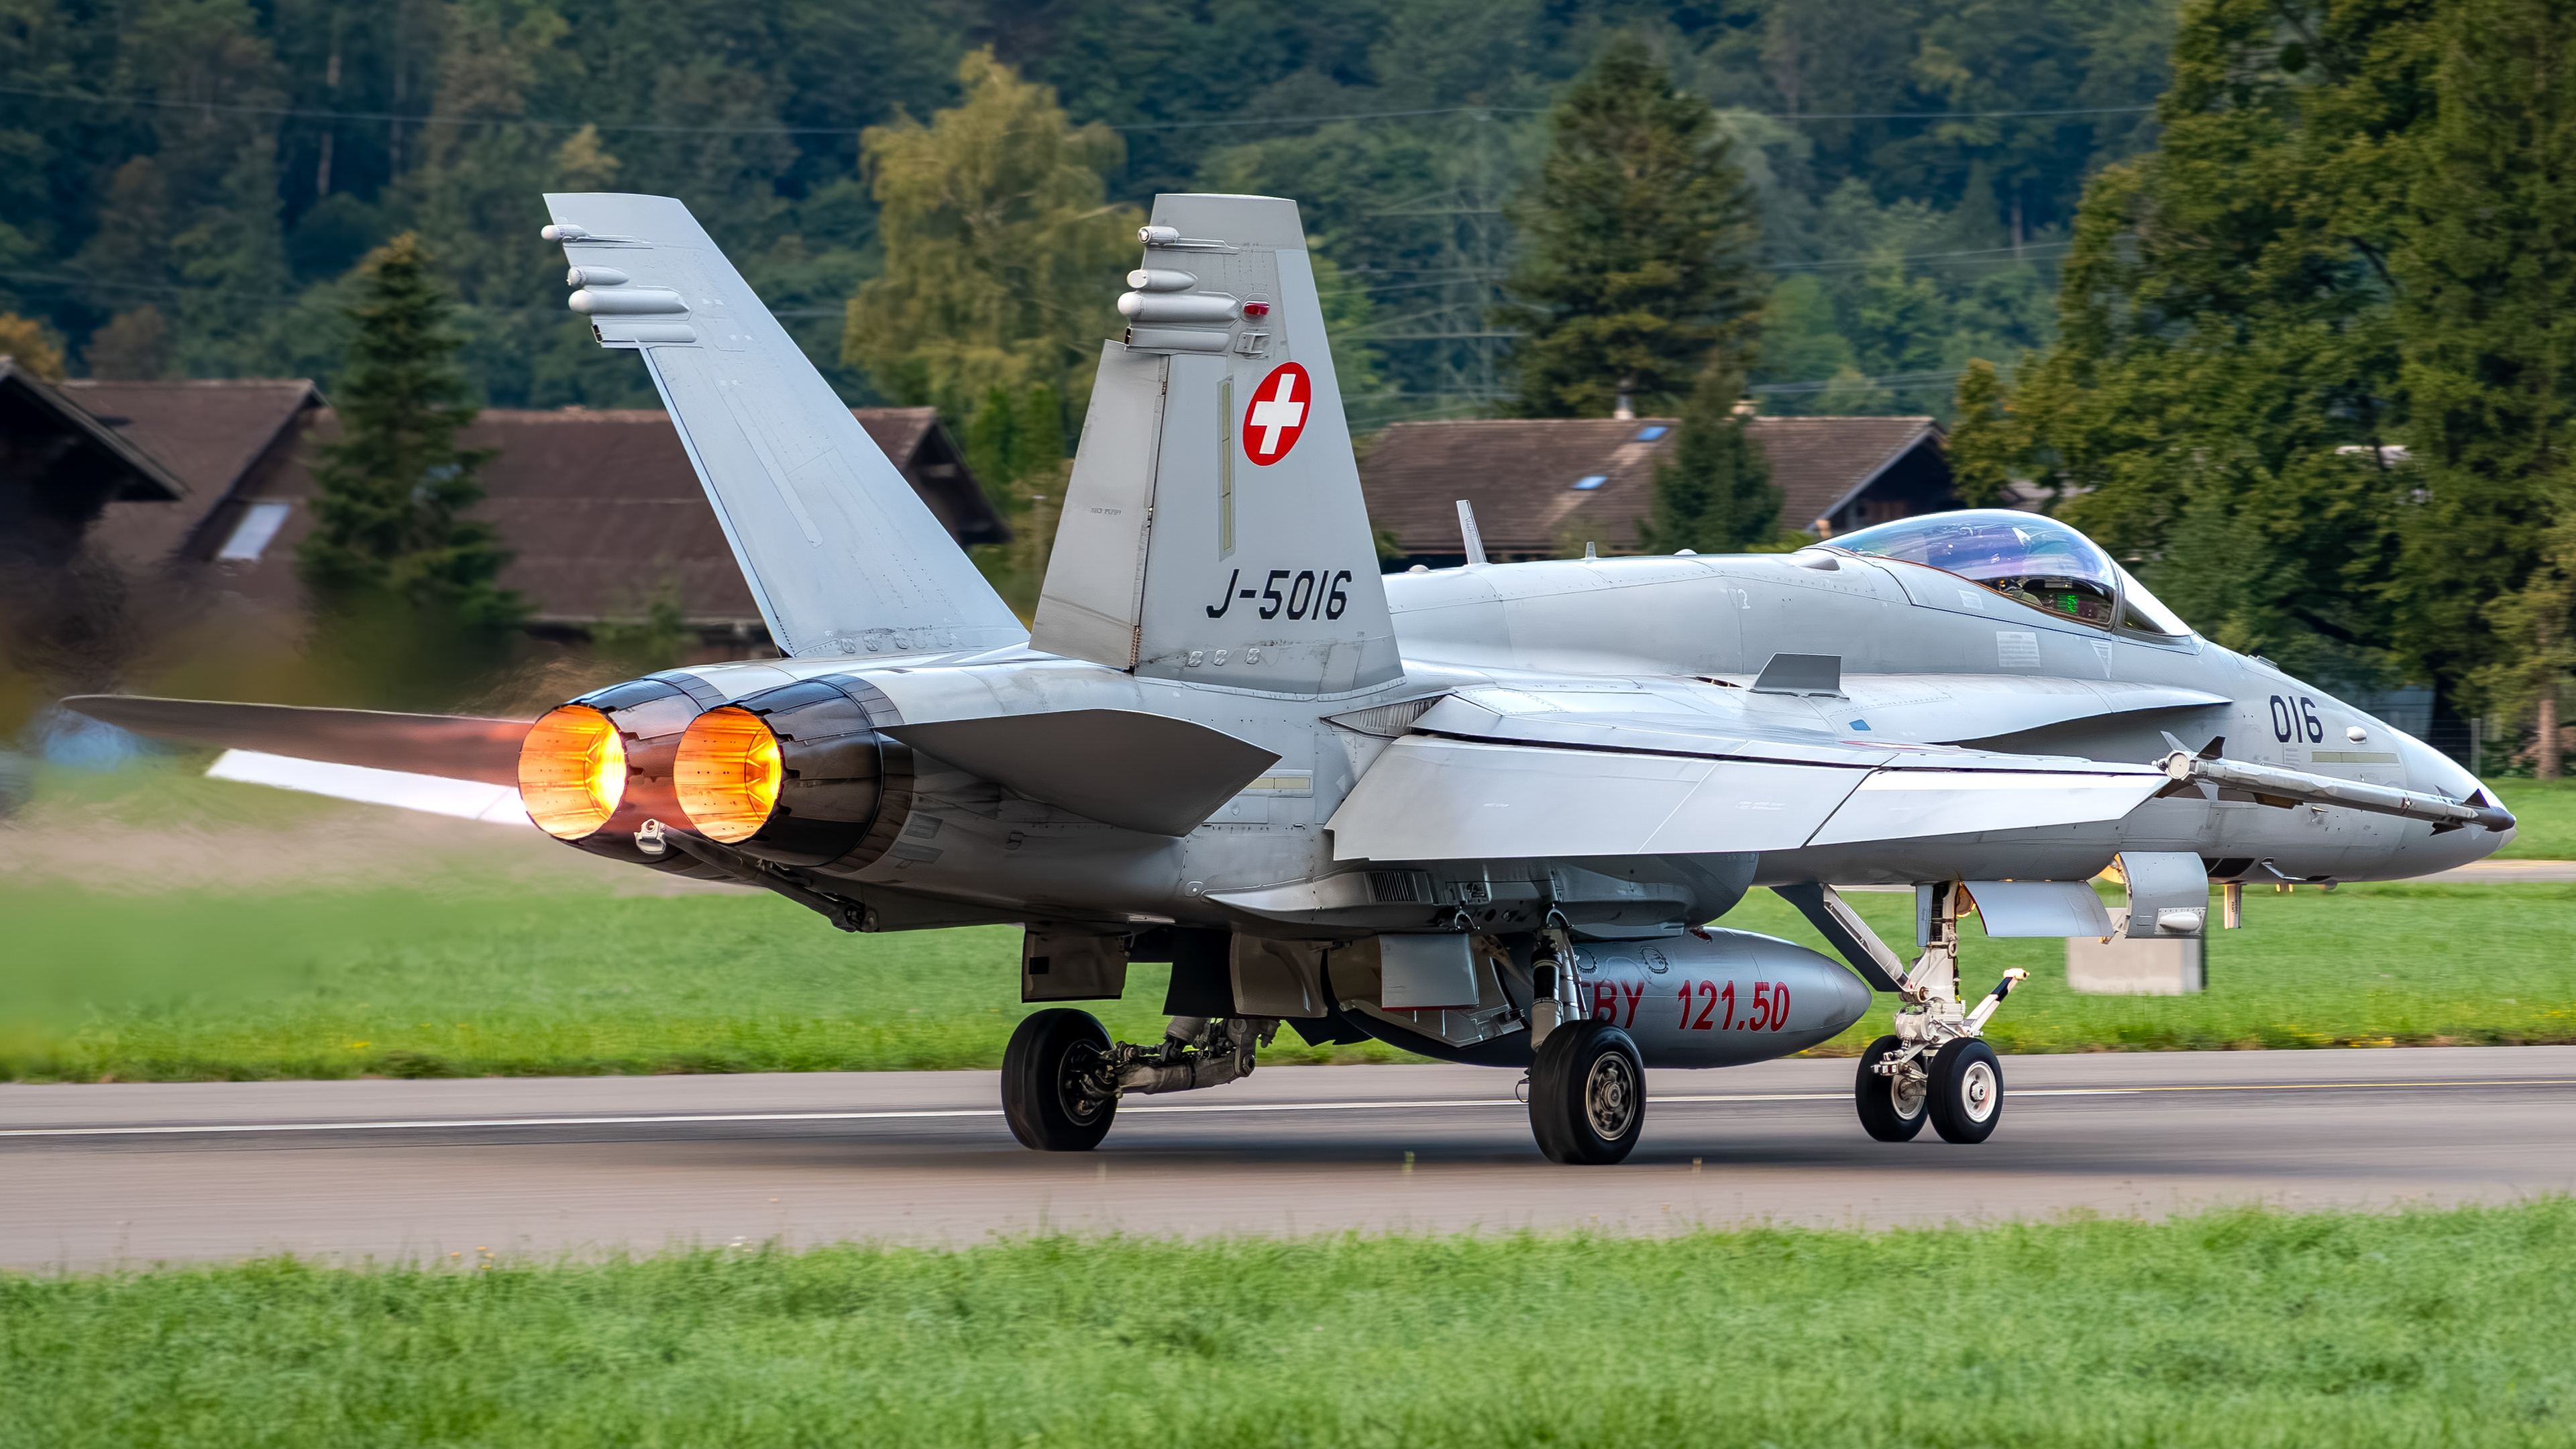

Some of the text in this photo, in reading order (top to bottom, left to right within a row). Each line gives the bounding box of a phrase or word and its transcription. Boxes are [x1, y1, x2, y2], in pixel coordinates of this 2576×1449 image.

[1206, 569, 1352, 621] J-5016
[2270, 695, 2323, 743] 016
[1678, 979, 1790, 1032] 121.50
